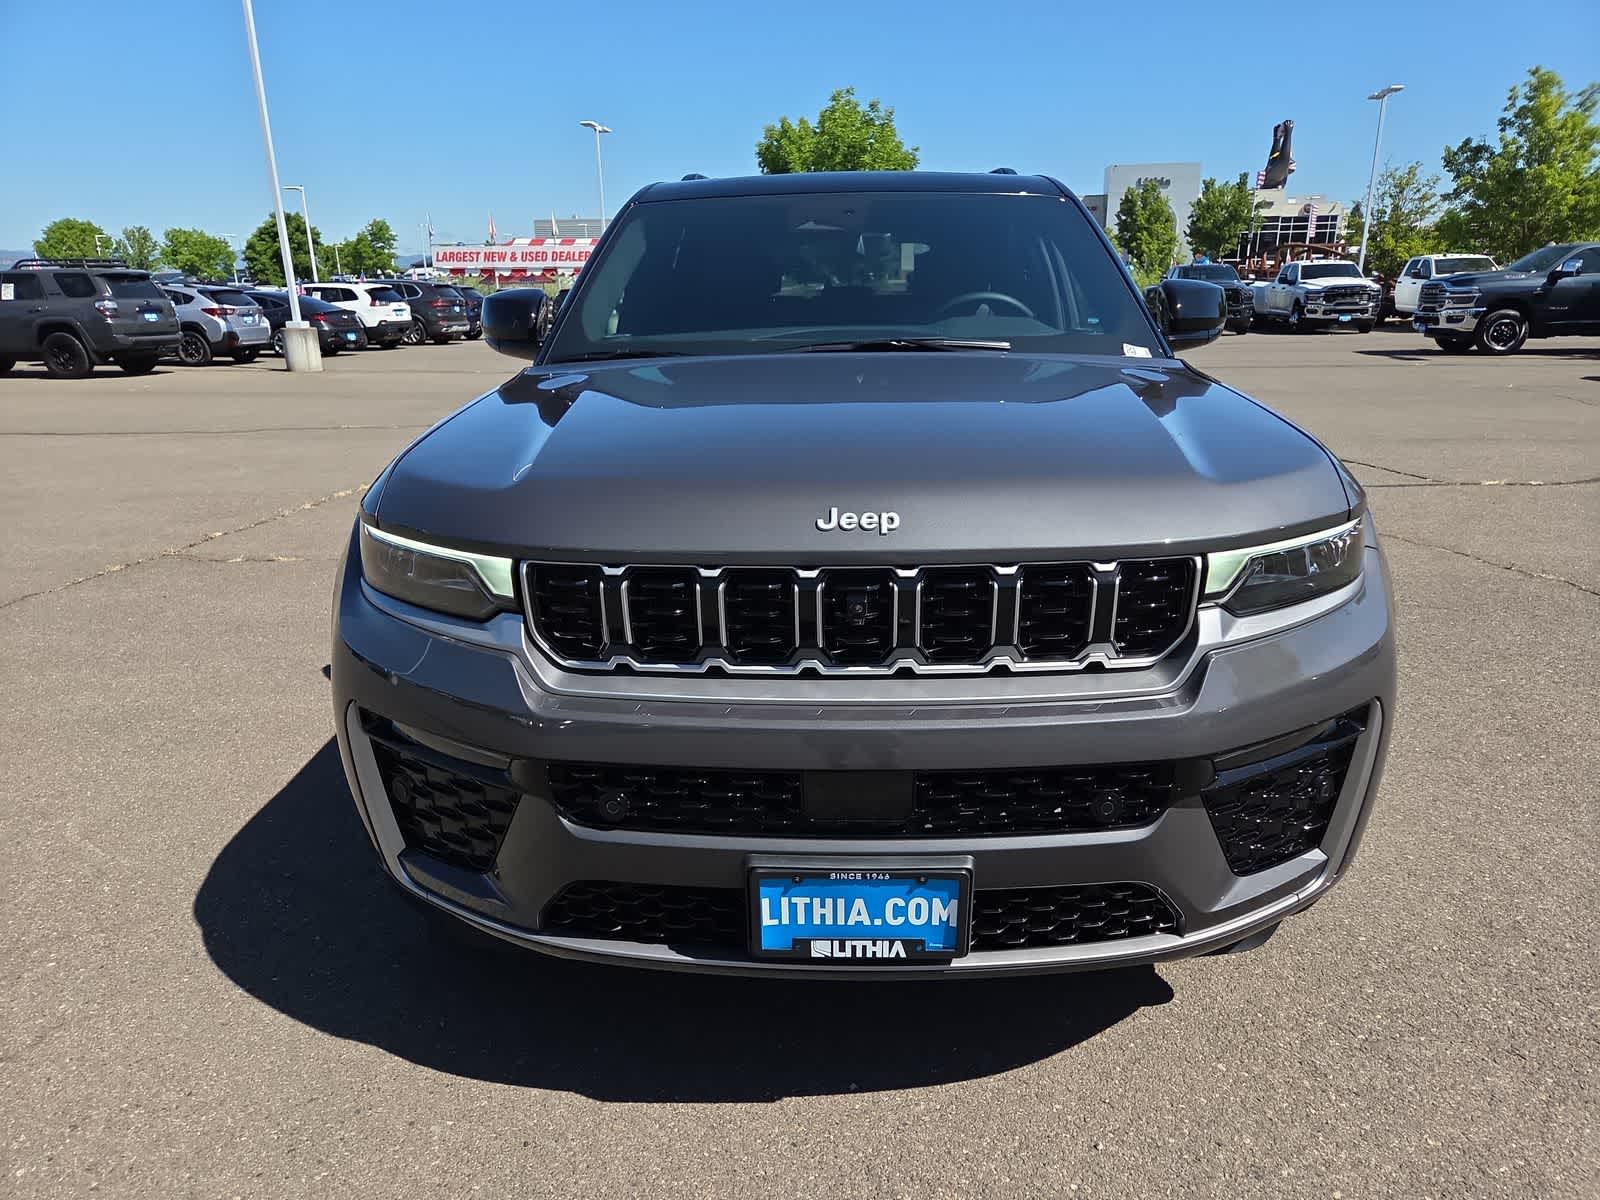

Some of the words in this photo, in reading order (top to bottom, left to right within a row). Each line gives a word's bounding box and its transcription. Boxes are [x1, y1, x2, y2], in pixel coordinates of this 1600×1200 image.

[436, 251, 480, 263] LARGEST
[483, 251, 507, 262] NEW
[509, 251, 518, 262] &
[521, 251, 548, 262] USED
[815, 506, 901, 536] Jeep
[829, 872, 862, 880] SINCE
[761, 896, 958, 927] LITHIA.COM
[832, 939, 907, 958] LITHIA
